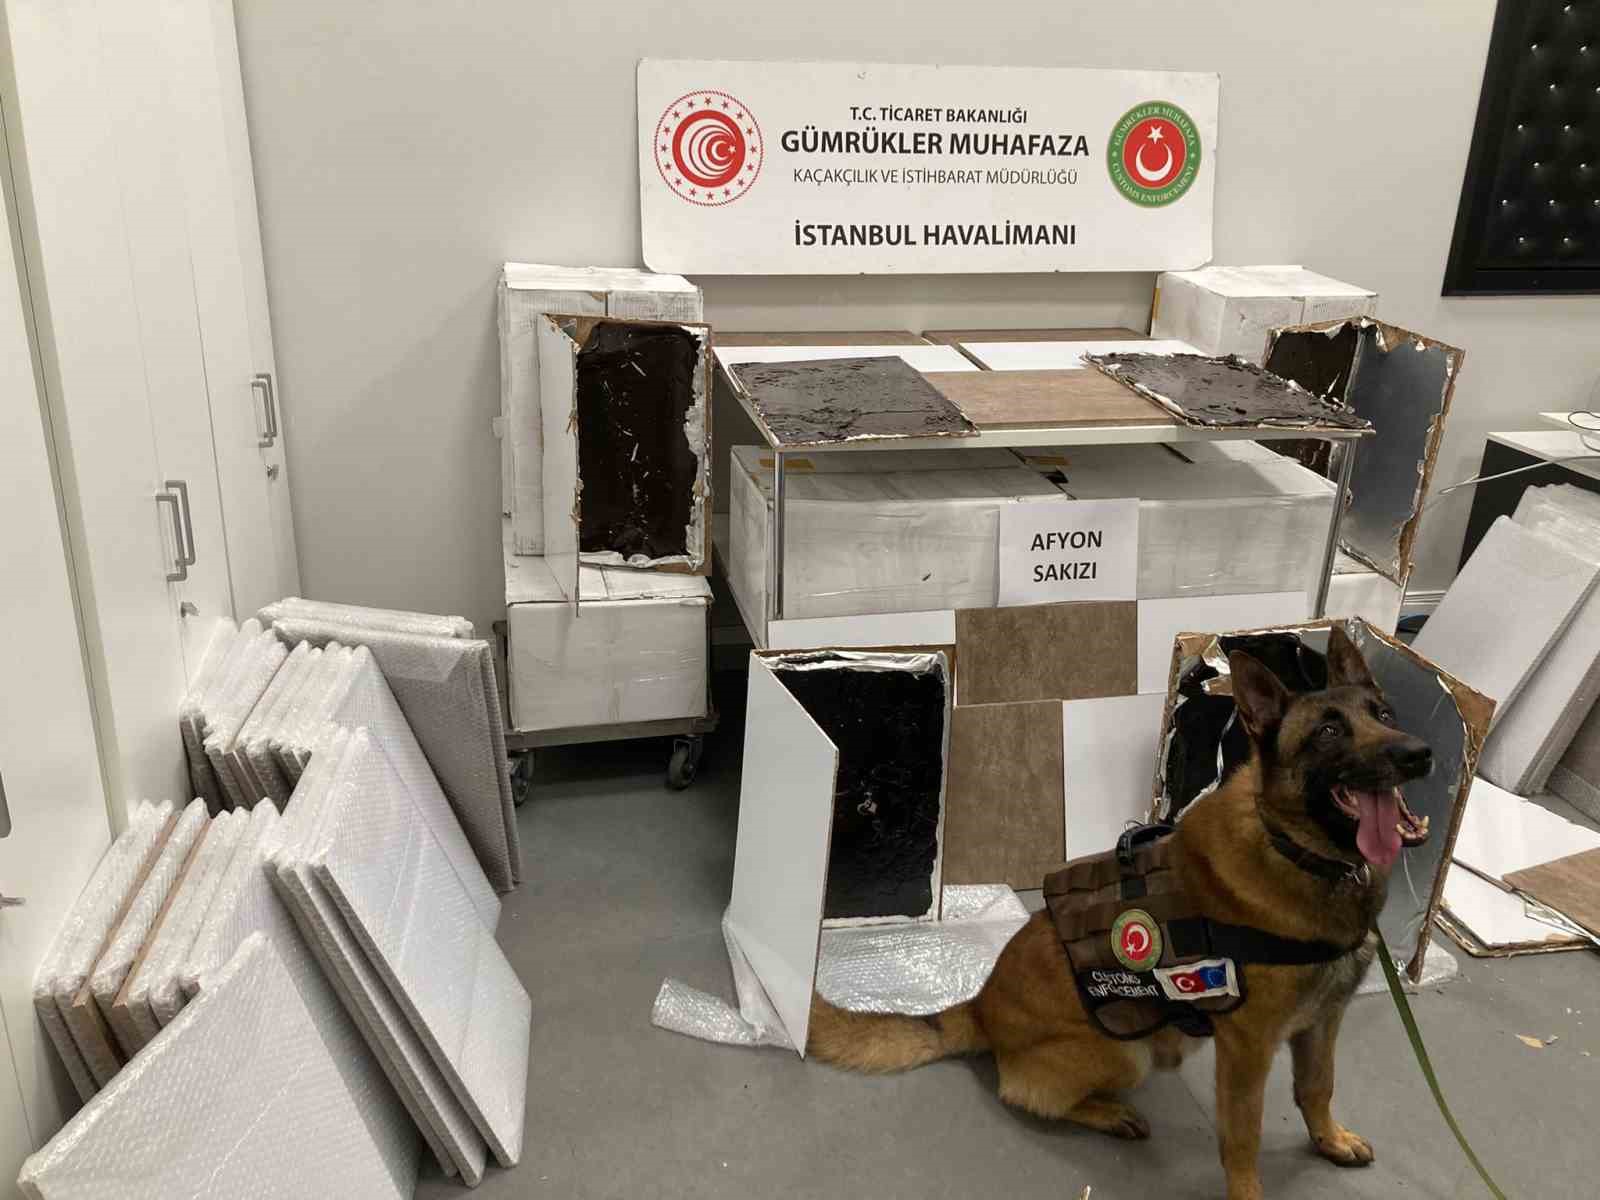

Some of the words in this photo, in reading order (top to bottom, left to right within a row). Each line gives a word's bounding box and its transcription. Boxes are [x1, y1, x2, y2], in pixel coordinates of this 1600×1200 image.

[849, 106, 877, 121] T.C.
[879, 103, 943, 122] TİCARET
[946, 107, 1028, 124] BAKANLIĞI
[780, 124, 943, 155] GÜMRÜKLER
[948, 132, 1090, 157] MUHAFAZA
[793, 167, 878, 187] KAÇAKÇILIK
[880, 168, 899, 184] VE
[902, 167, 983, 185] İSTİHBARAT
[985, 167, 1079, 186] MÜDÜRLÜĞÜ
[794, 218, 918, 247] İSTANBUL
[922, 219, 1077, 247] HAVALİMANI
[1030, 529, 1103, 552] AFYON
[1032, 561, 1098, 583] SAKIZI
